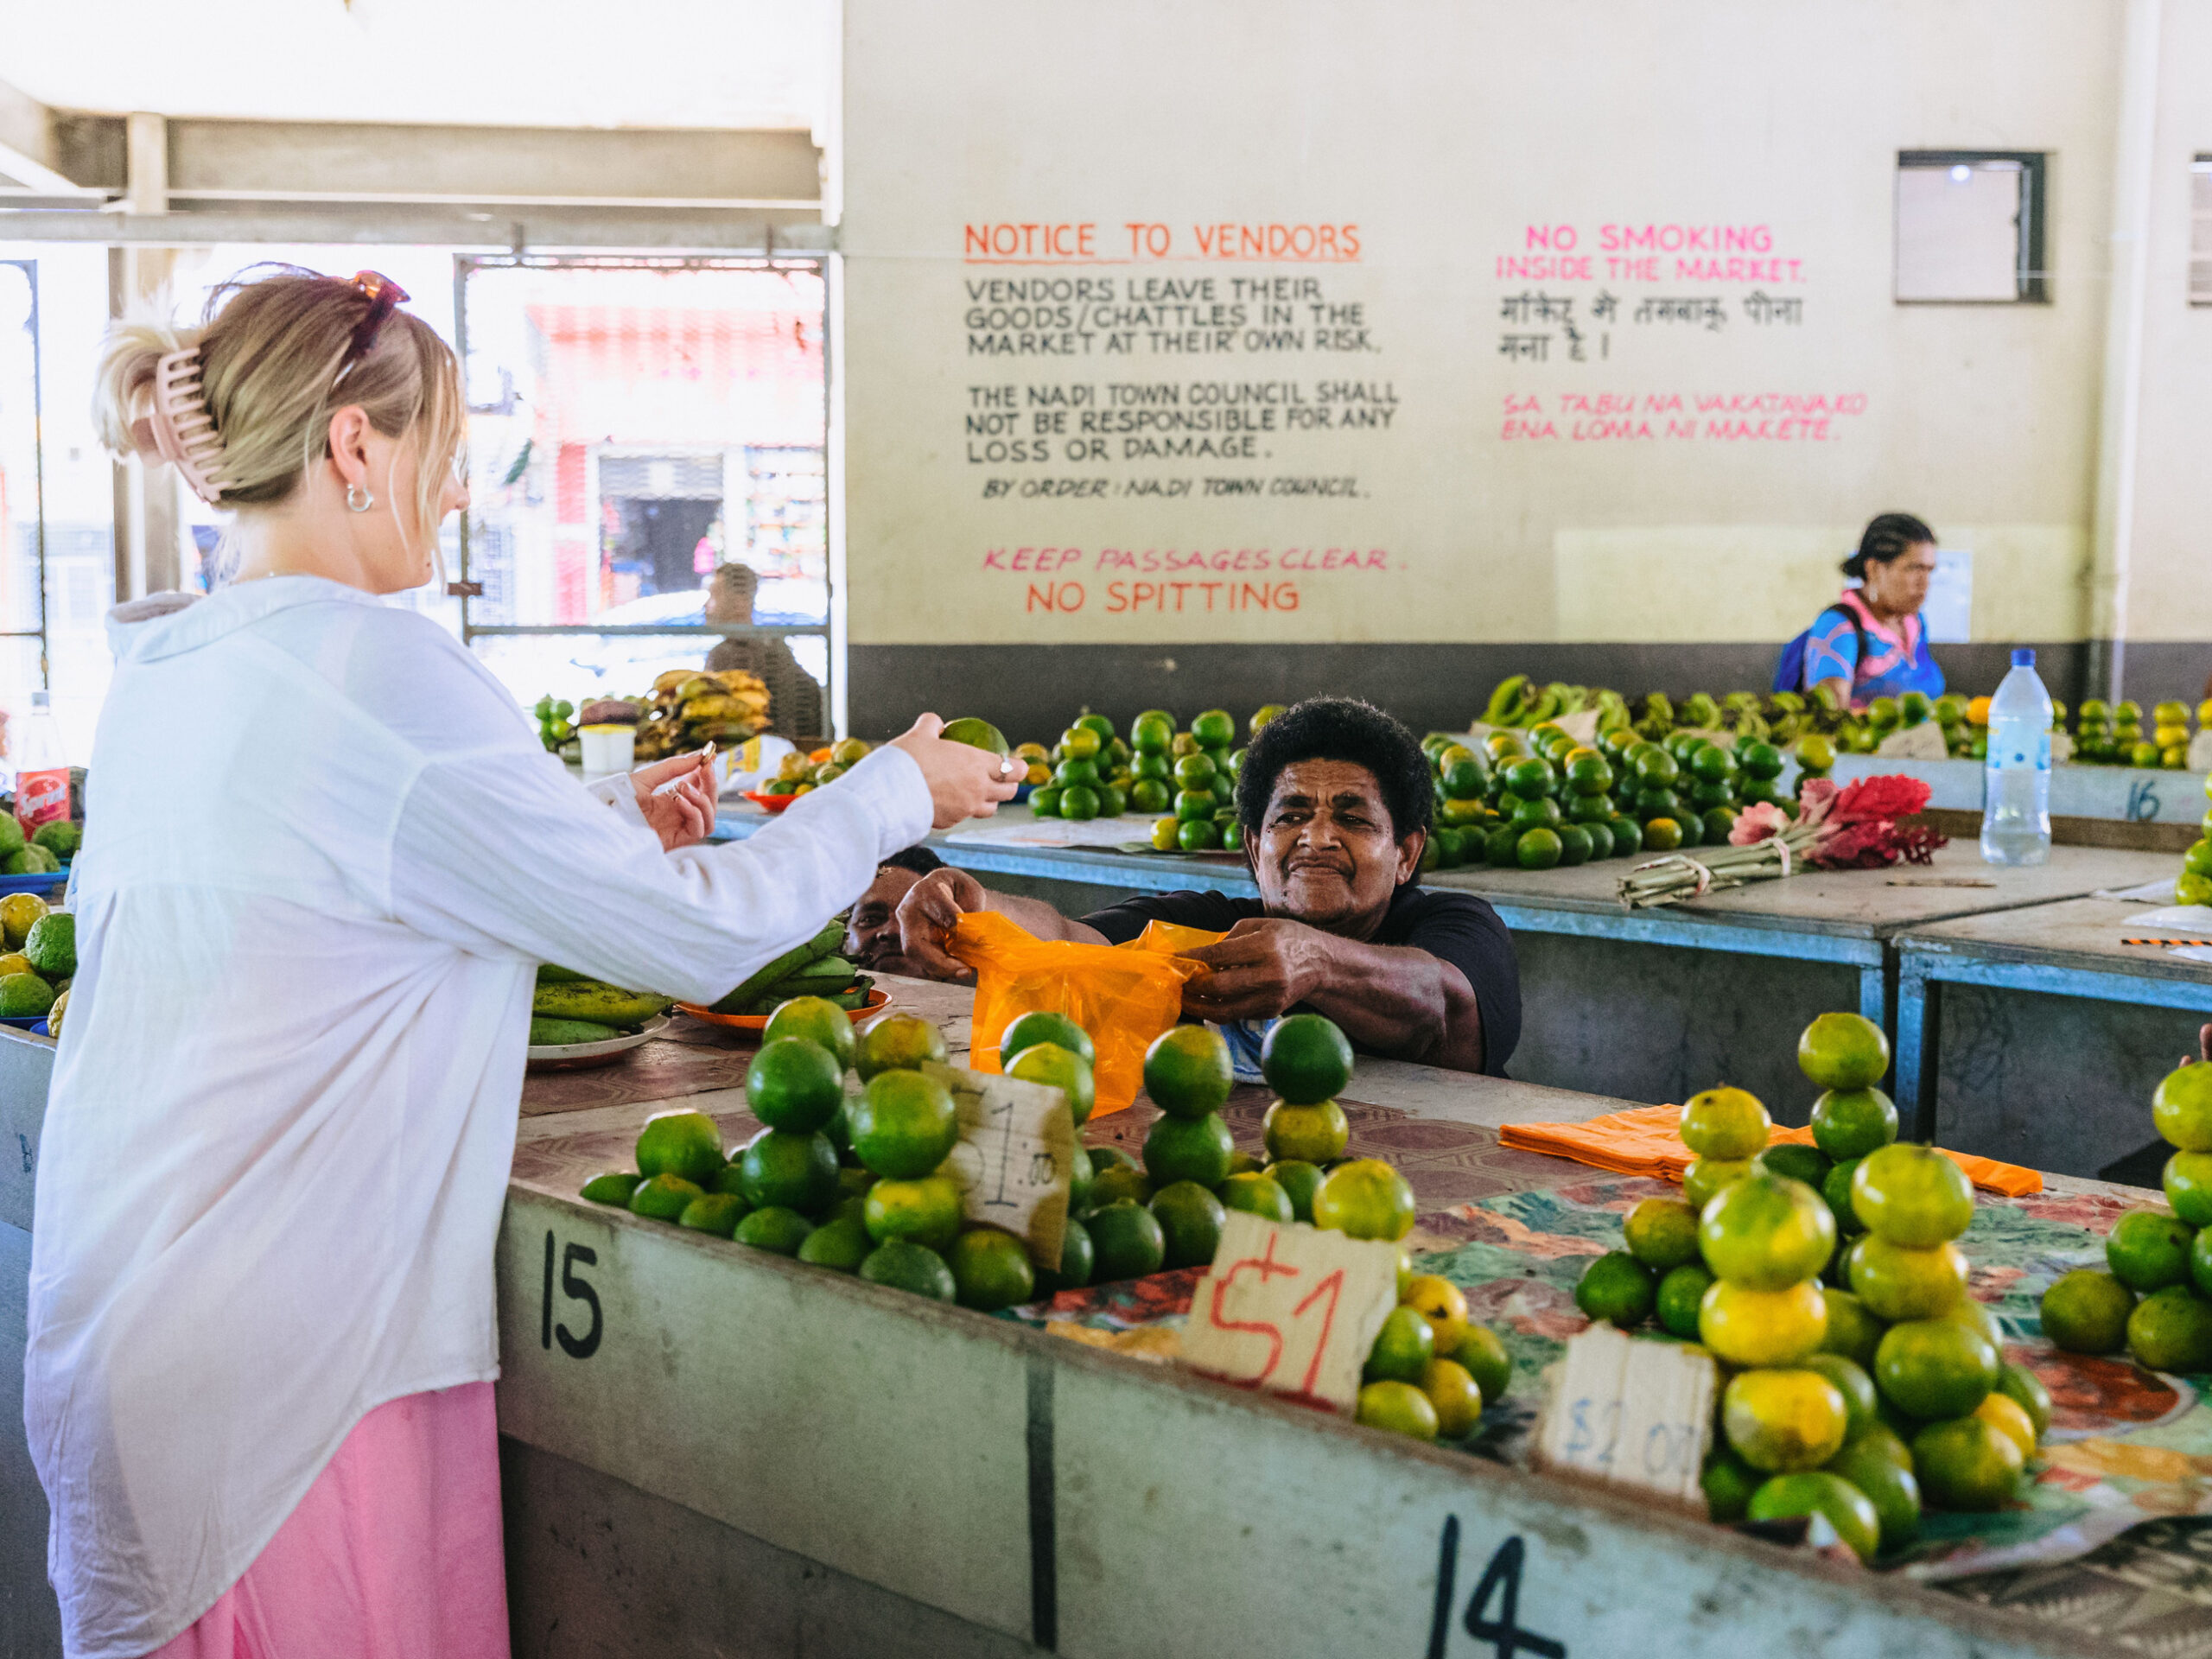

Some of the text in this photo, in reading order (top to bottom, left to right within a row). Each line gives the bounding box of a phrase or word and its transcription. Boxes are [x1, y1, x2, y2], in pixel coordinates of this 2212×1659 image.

[964, 223, 1362, 257] NOTICE TO VENDORS
[1525, 224, 1774, 253] NO SMOKING
[1496, 256, 1594, 281] INSIDE
[1605, 256, 1660, 282] THE
[964, 276, 1323, 302] VENDORS LEAVE THEIR
[964, 302, 1365, 335] GOODS/CHATTLES IN THE
[967, 331, 1096, 356] MARKET
[1103, 331, 1137, 354] AT
[1147, 330, 1238, 354] THEIR
[1243, 329, 1306, 353] OWN
[968, 381, 1401, 409] THE NADI TOWN COUNCIL SHALL
[1503, 394, 1542, 416] SA
[1560, 393, 1636, 416] TABU
[1644, 394, 1683, 414] NA
[965, 407, 1396, 436] NOT BE RESPONSIBLE FOR ANY
[1500, 418, 1559, 441] ENA
[1572, 418, 1656, 442] LOMA
[1666, 419, 1697, 440] NI
[967, 435, 1272, 465] LOSS OR DAMAGE.
[982, 477, 1017, 499] BY
[1124, 477, 1193, 499] NADI
[1203, 477, 1264, 498] TOWN
[1268, 476, 1371, 499] COUNCIL.
[982, 547, 1408, 573] KEEP PASSAGES CLEAR.
[1026, 580, 1300, 614] NO SPITTING
[2126, 779, 2160, 822] 16
[542, 1229, 604, 1359] 15
[1191, 1231, 1347, 1413] $1
[1427, 1513, 1567, 1659] 14
